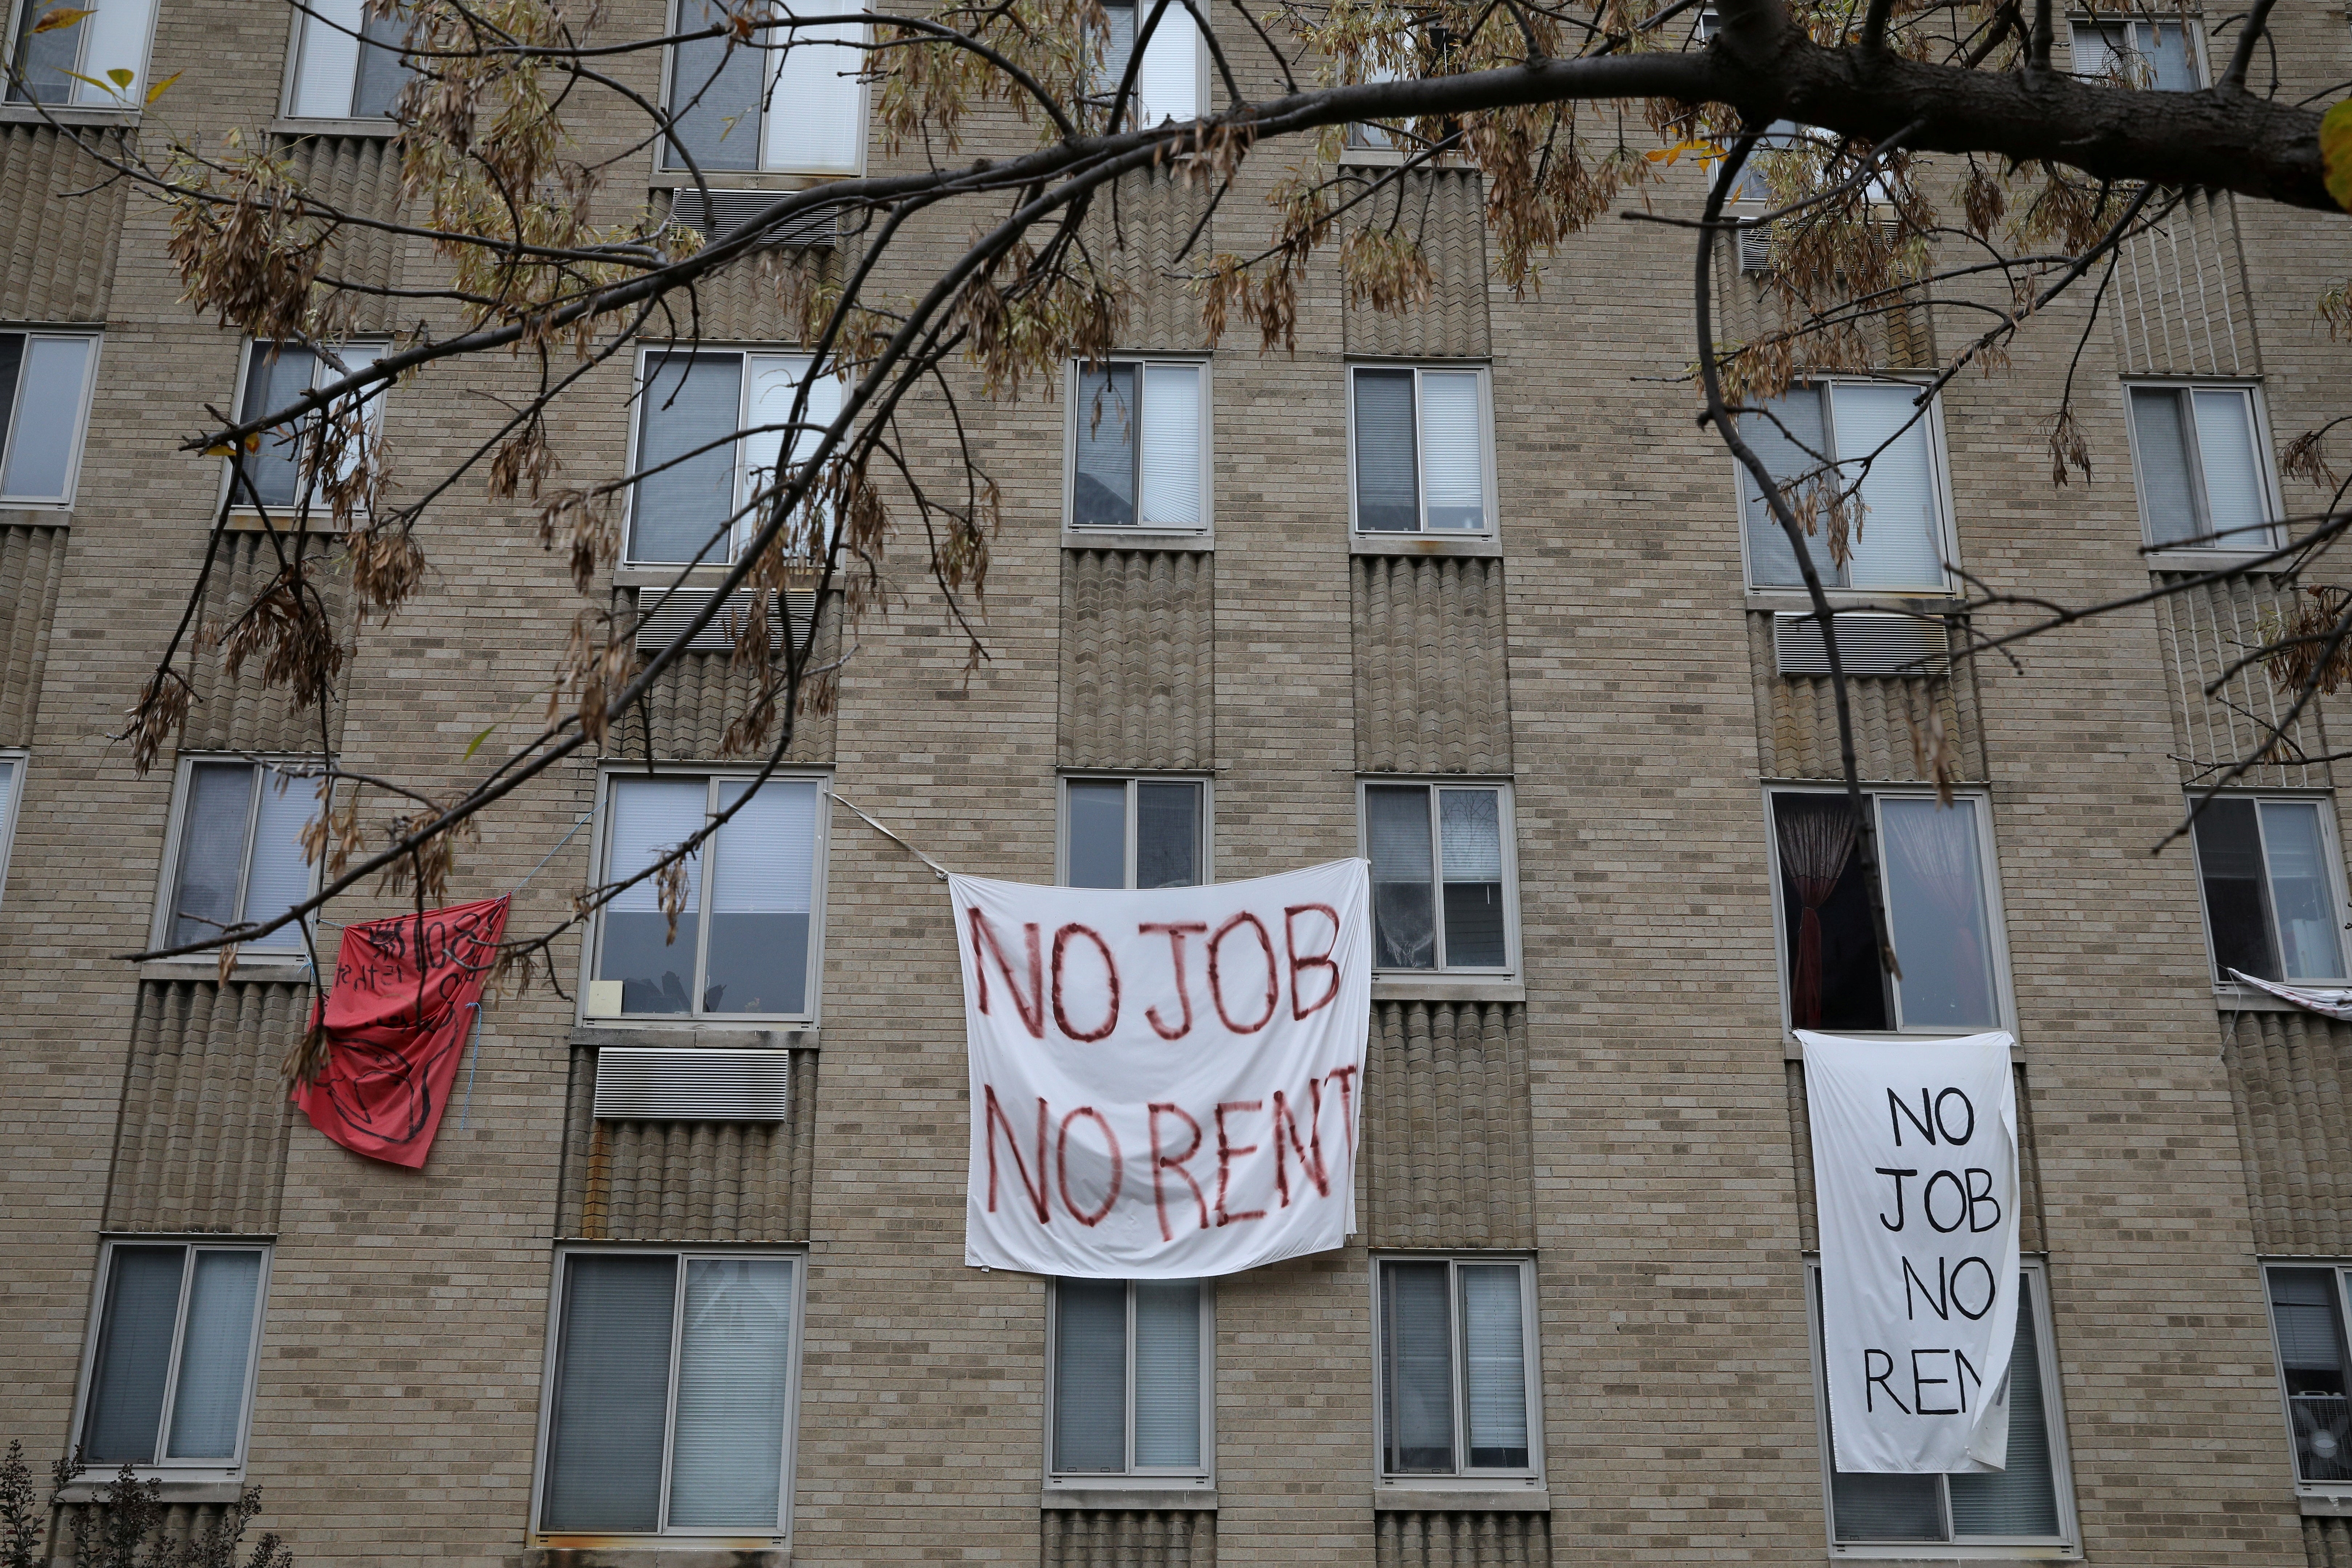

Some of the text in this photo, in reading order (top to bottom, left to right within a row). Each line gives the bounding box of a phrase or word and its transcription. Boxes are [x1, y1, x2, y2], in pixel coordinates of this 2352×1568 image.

[969, 904, 1339, 1043] NO JOB
[1887, 1087, 1974, 1146] NO
[985, 1065, 1356, 1241] NO RENT
[1875, 1167, 2001, 1233] JOB
[1902, 1256, 1995, 1320] NO
[1864, 1349, 1981, 1415] REN
